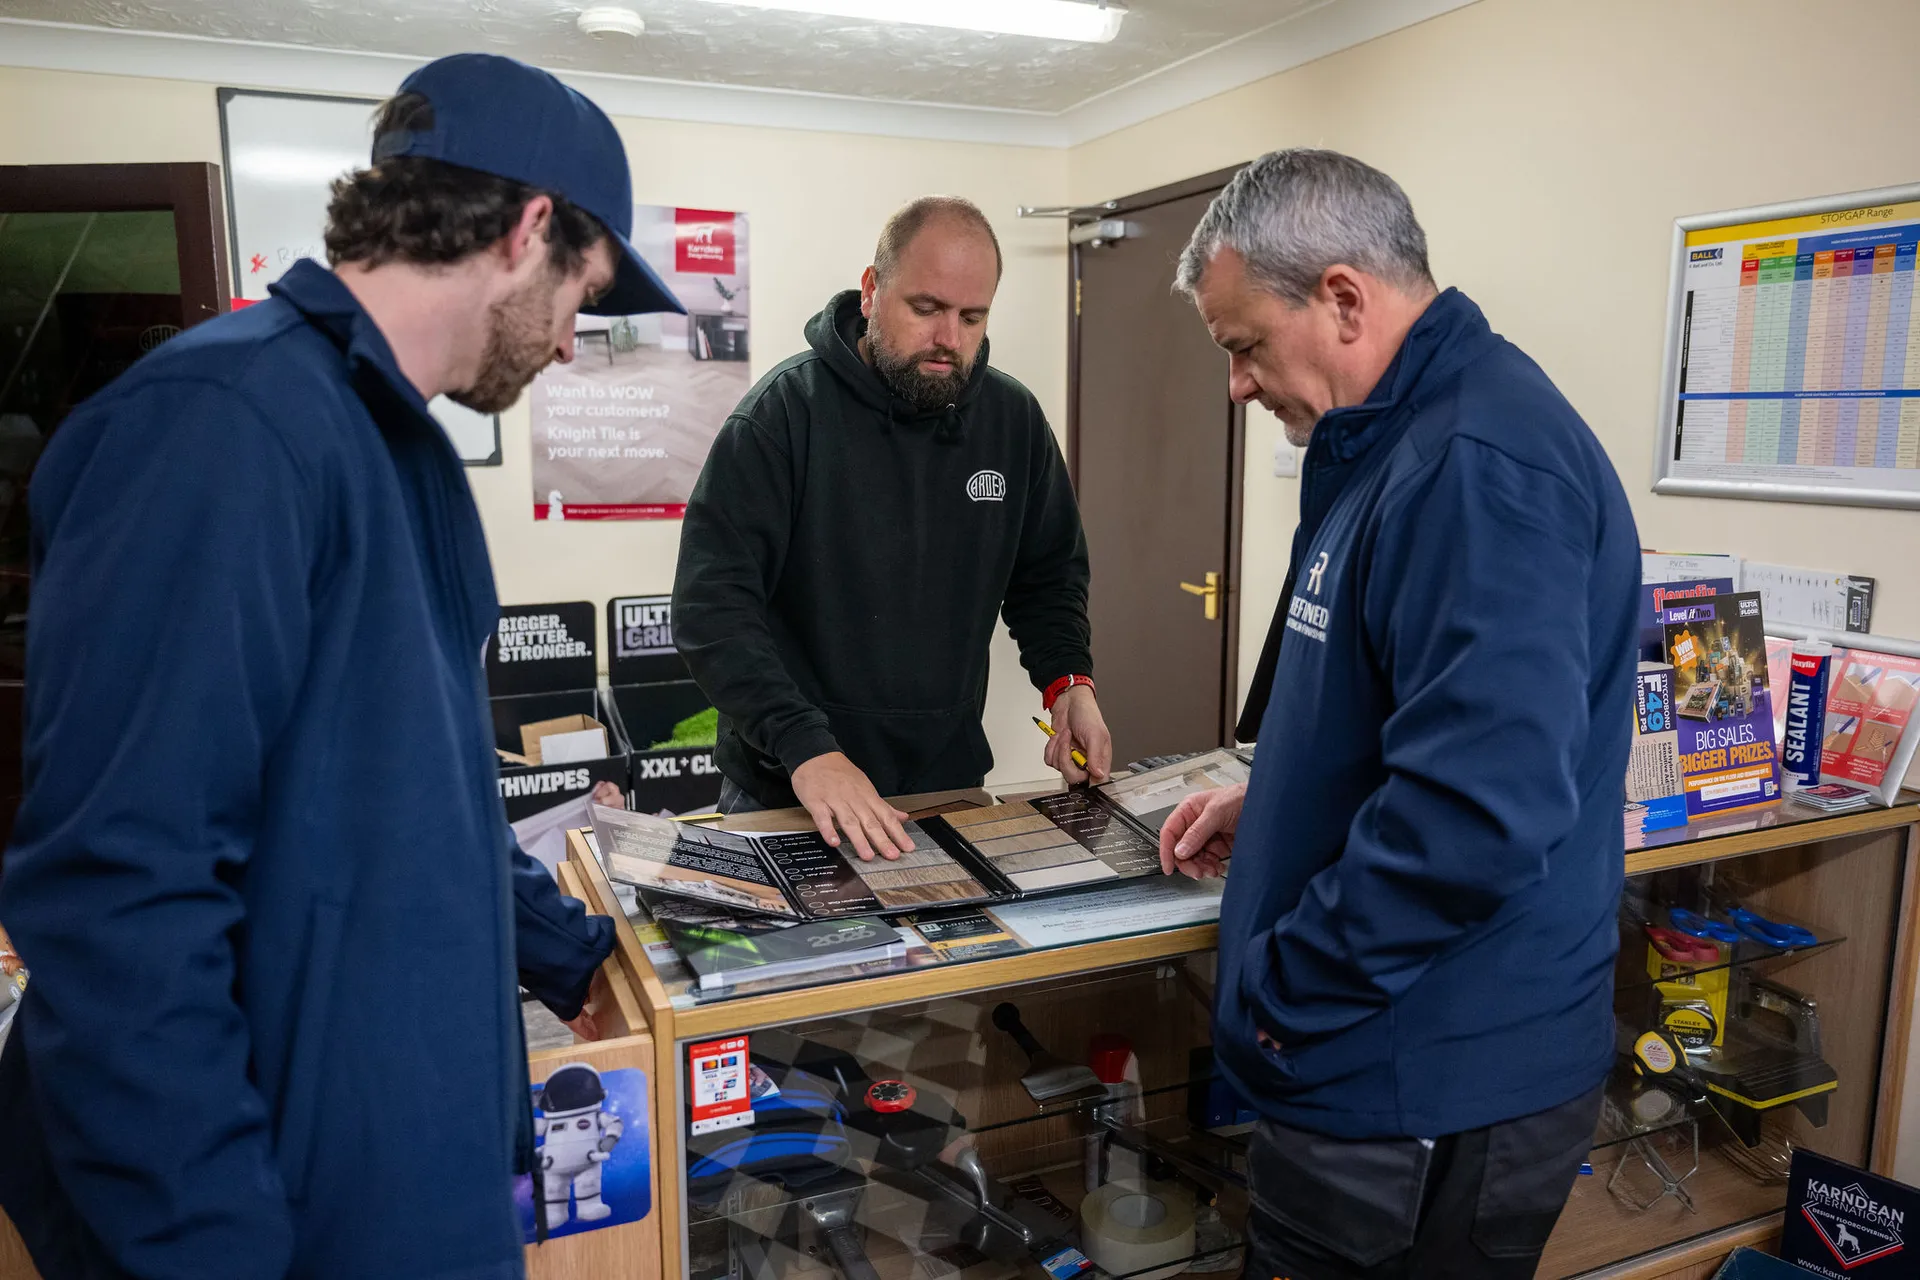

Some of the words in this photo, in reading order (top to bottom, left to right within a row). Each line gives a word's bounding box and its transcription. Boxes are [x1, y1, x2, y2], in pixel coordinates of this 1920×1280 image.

[1821, 210, 1865, 224] STOPGAP
[1867, 208, 1894, 219] Range
[1692, 251, 1713, 260] BALL
[546, 384, 586, 398] Want
[590, 385, 606, 398] to
[609, 385, 655, 400] WOW
[547, 405, 584, 418] your
[585, 404, 670, 418] customers?
[547, 426, 596, 443] Knight
[599, 426, 625, 441] Tile
[629, 427, 641, 441] is
[548, 446, 585, 460] your
[588, 445, 620, 459] next
[624, 447, 669, 459] move.
[969, 473, 1004, 498] ARDEX
[498, 614, 566, 632] BIGGER.
[1669, 610, 1688, 621] Level
[1697, 609, 1711, 618] Two
[499, 631, 574, 647] WETTER.
[1675, 638, 1694, 656] WIN
[498, 642, 592, 663] STRONGER.
[1637, 675, 1646, 715] HYBRID
[1644, 673, 1664, 732] F49
[1661, 673, 1671, 730] STYCCOBOND
[1640, 717, 1648, 733] PS
[1786, 681, 1811, 763] SEALANT
[1695, 729, 1716, 751] BIG
[1718, 723, 1757, 747] SALES.
[691, 755, 722, 774] CL
[1680, 749, 1727, 773] BIGGER
[1729, 741, 1774, 766] PRIZES.
[940, 917, 988, 929] FLOORING
[1668, 1025, 1706, 1036] PowerLock
[1673, 1019, 1701, 1027] STANLEY
[1807, 1178, 1905, 1224] KARNDEAN
[1806, 1190, 1902, 1233] INTERNATIONAL
[1812, 1207, 1835, 1220] DESIGN
[1836, 1216, 1894, 1242] FLOORCOVERINGS
